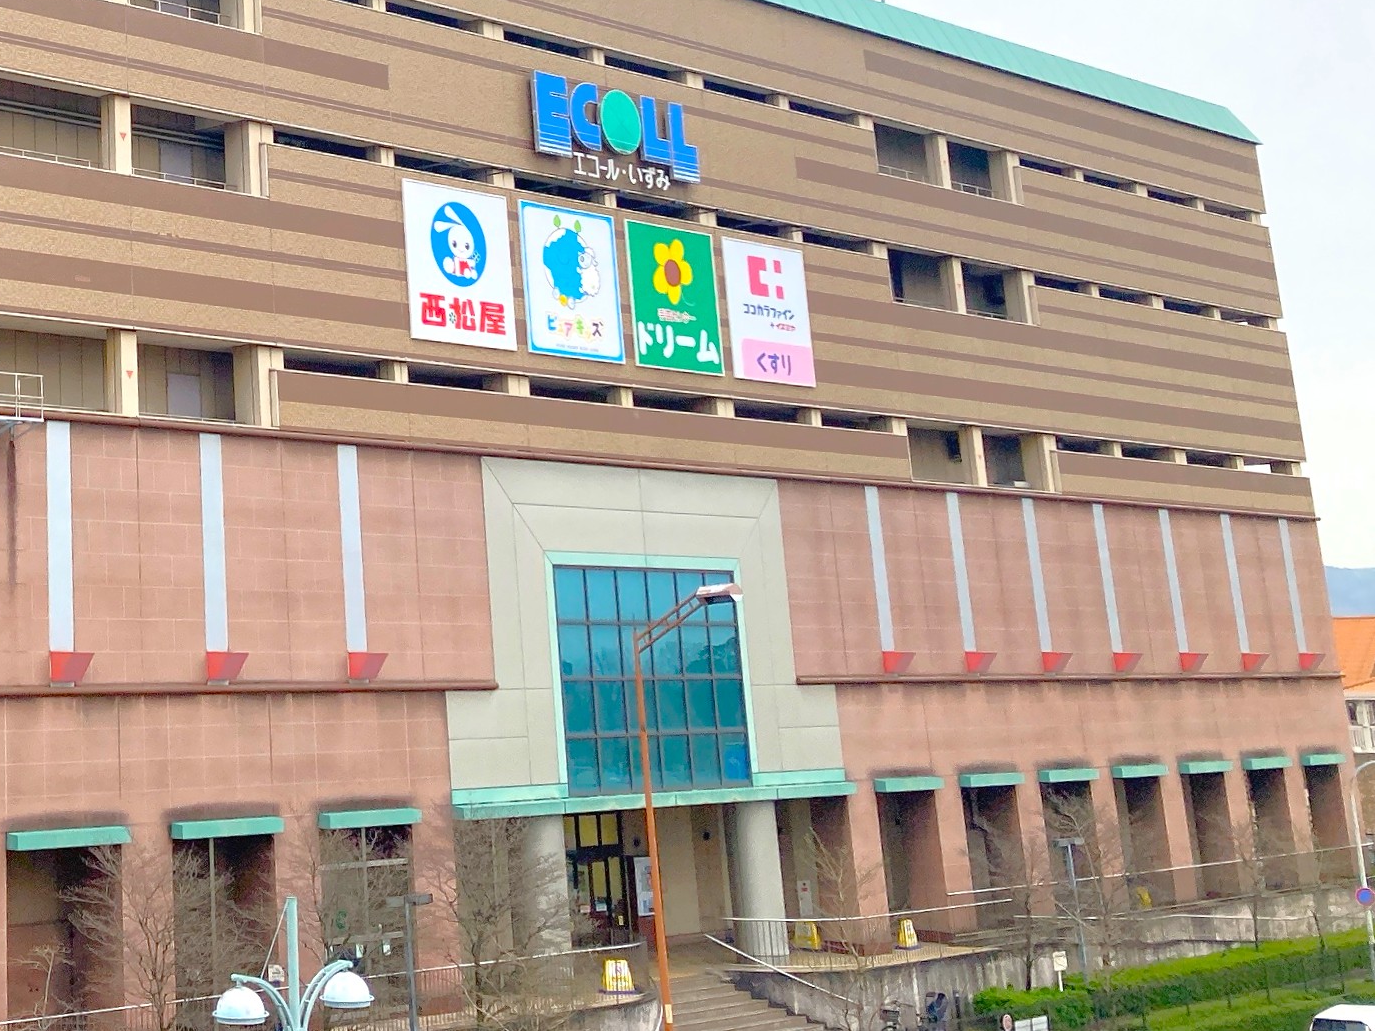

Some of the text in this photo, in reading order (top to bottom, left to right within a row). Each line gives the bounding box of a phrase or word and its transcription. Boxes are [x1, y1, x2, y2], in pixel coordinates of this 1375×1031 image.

[532, 69, 701, 183] ECOLL
[573, 151, 671, 191] エコール・いずみ
[419, 292, 507, 336] 西松屋
[637, 320, 720, 365] ドリーム
[756, 352, 792, 376] くすり
